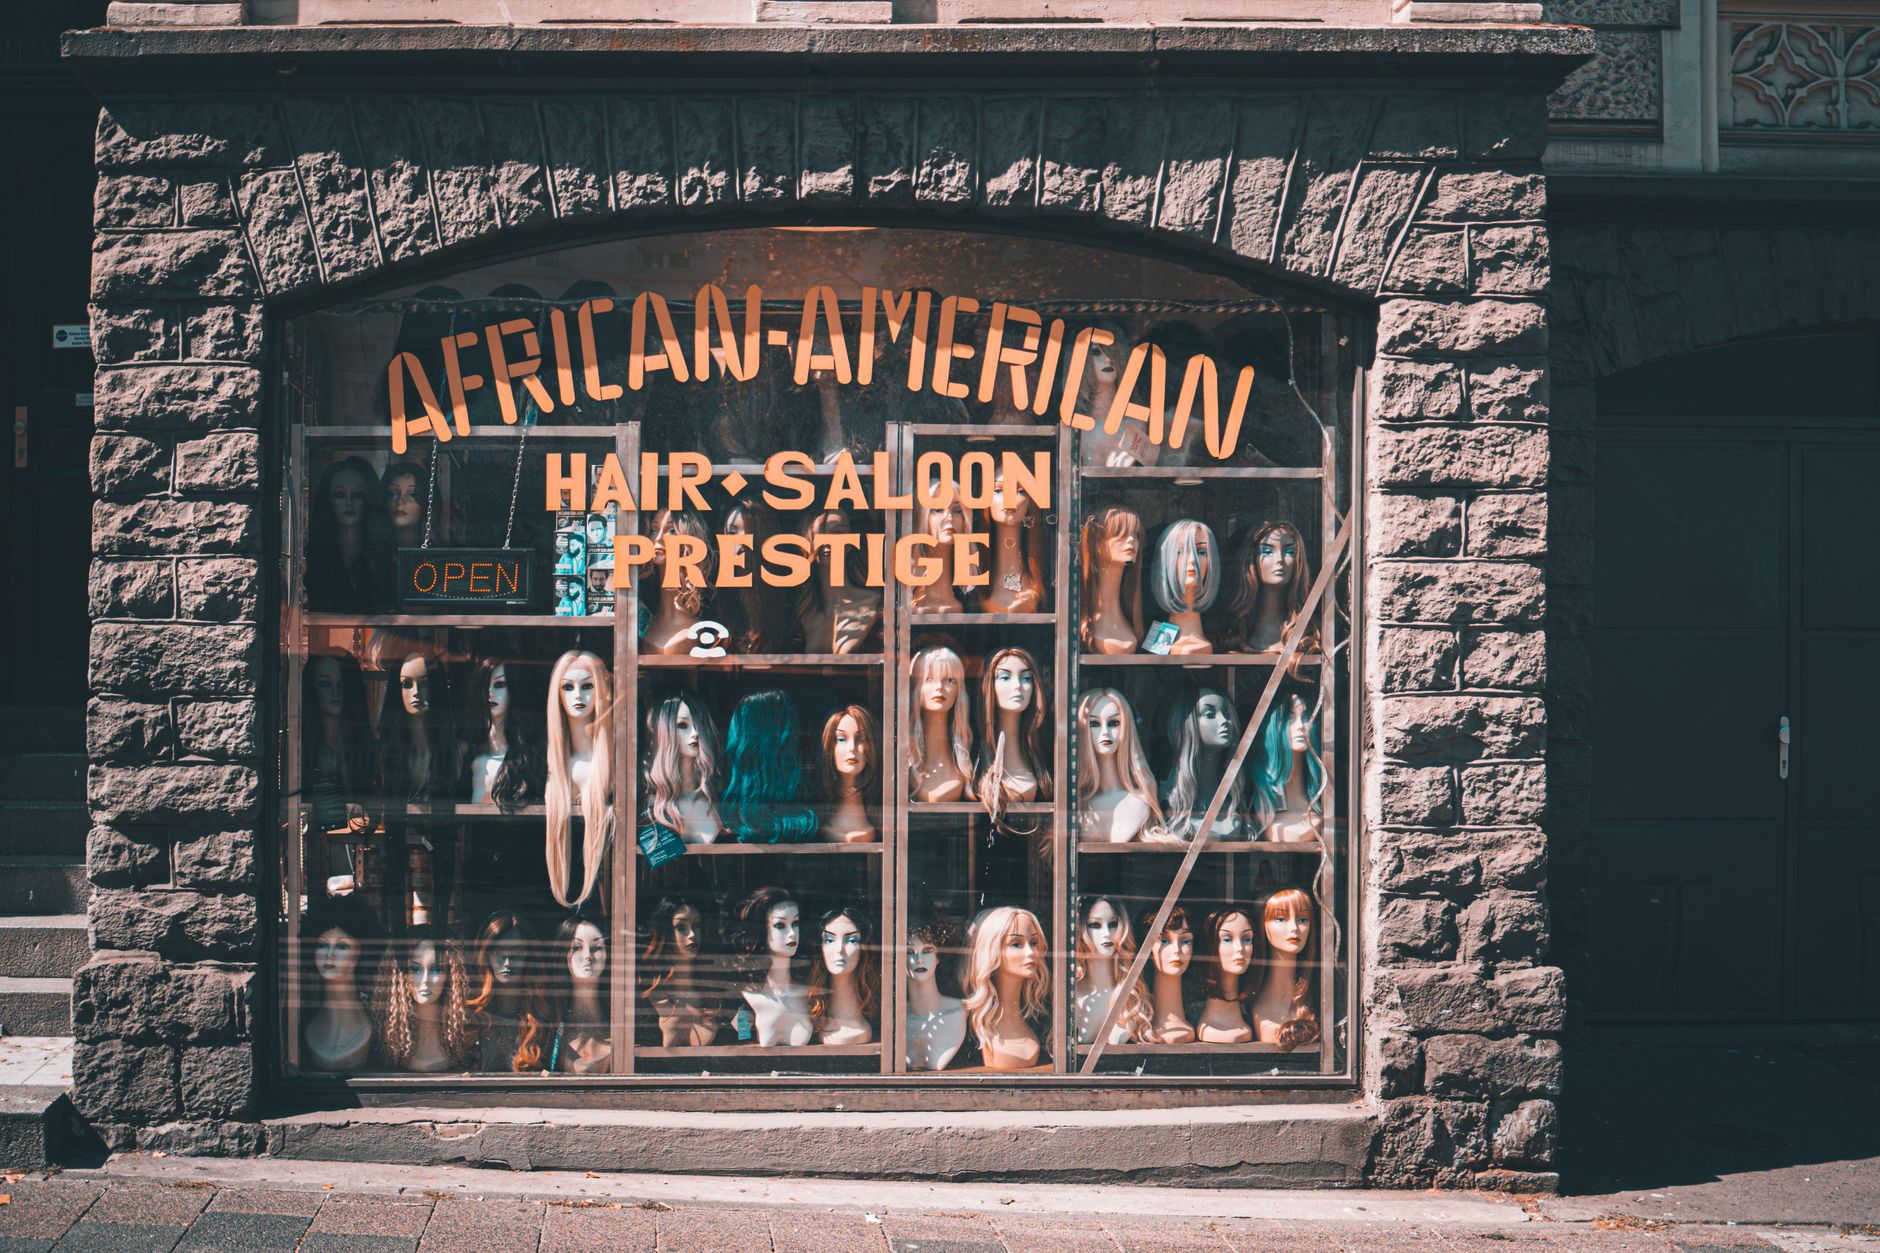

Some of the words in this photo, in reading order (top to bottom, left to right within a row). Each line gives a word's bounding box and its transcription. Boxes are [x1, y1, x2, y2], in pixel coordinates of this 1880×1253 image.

[388, 284, 1255, 459] AFRICAN-AMERICAN
[546, 452, 713, 511] HAIR
[762, 451, 1051, 510] SALOON
[413, 563, 519, 592] OPEN
[612, 532, 990, 588] PRESTIGE
